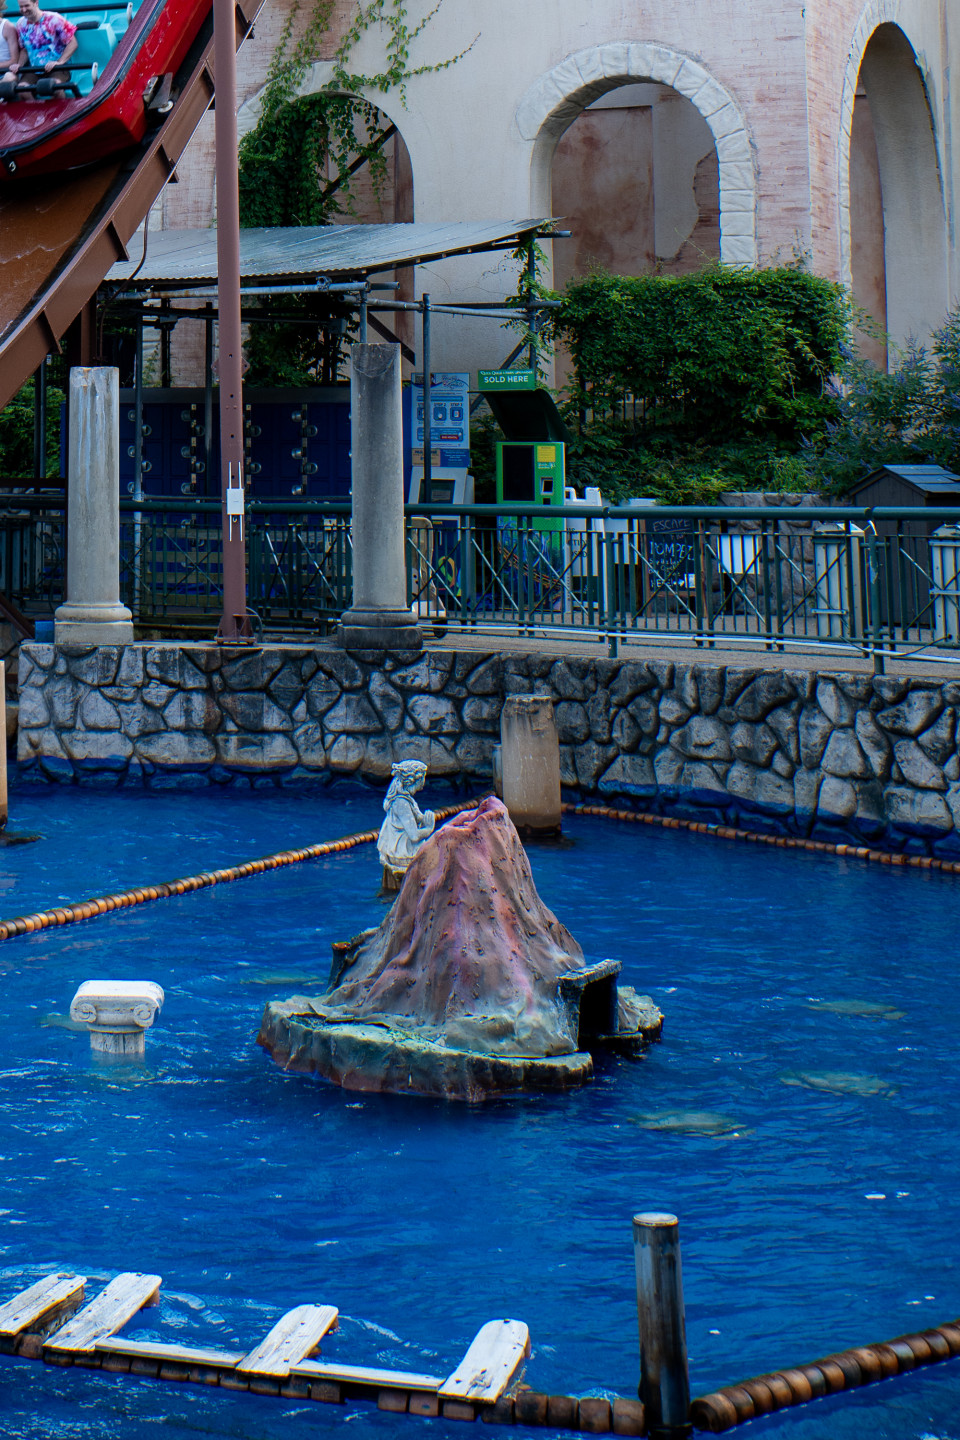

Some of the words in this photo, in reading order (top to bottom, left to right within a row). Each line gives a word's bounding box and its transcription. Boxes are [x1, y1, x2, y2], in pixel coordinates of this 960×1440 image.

[8, 160, 17, 172] 3
[484, 375, 506, 384] SOLD
[507, 375, 529, 383] HERE
[652, 519, 691, 532] ESCAPE
